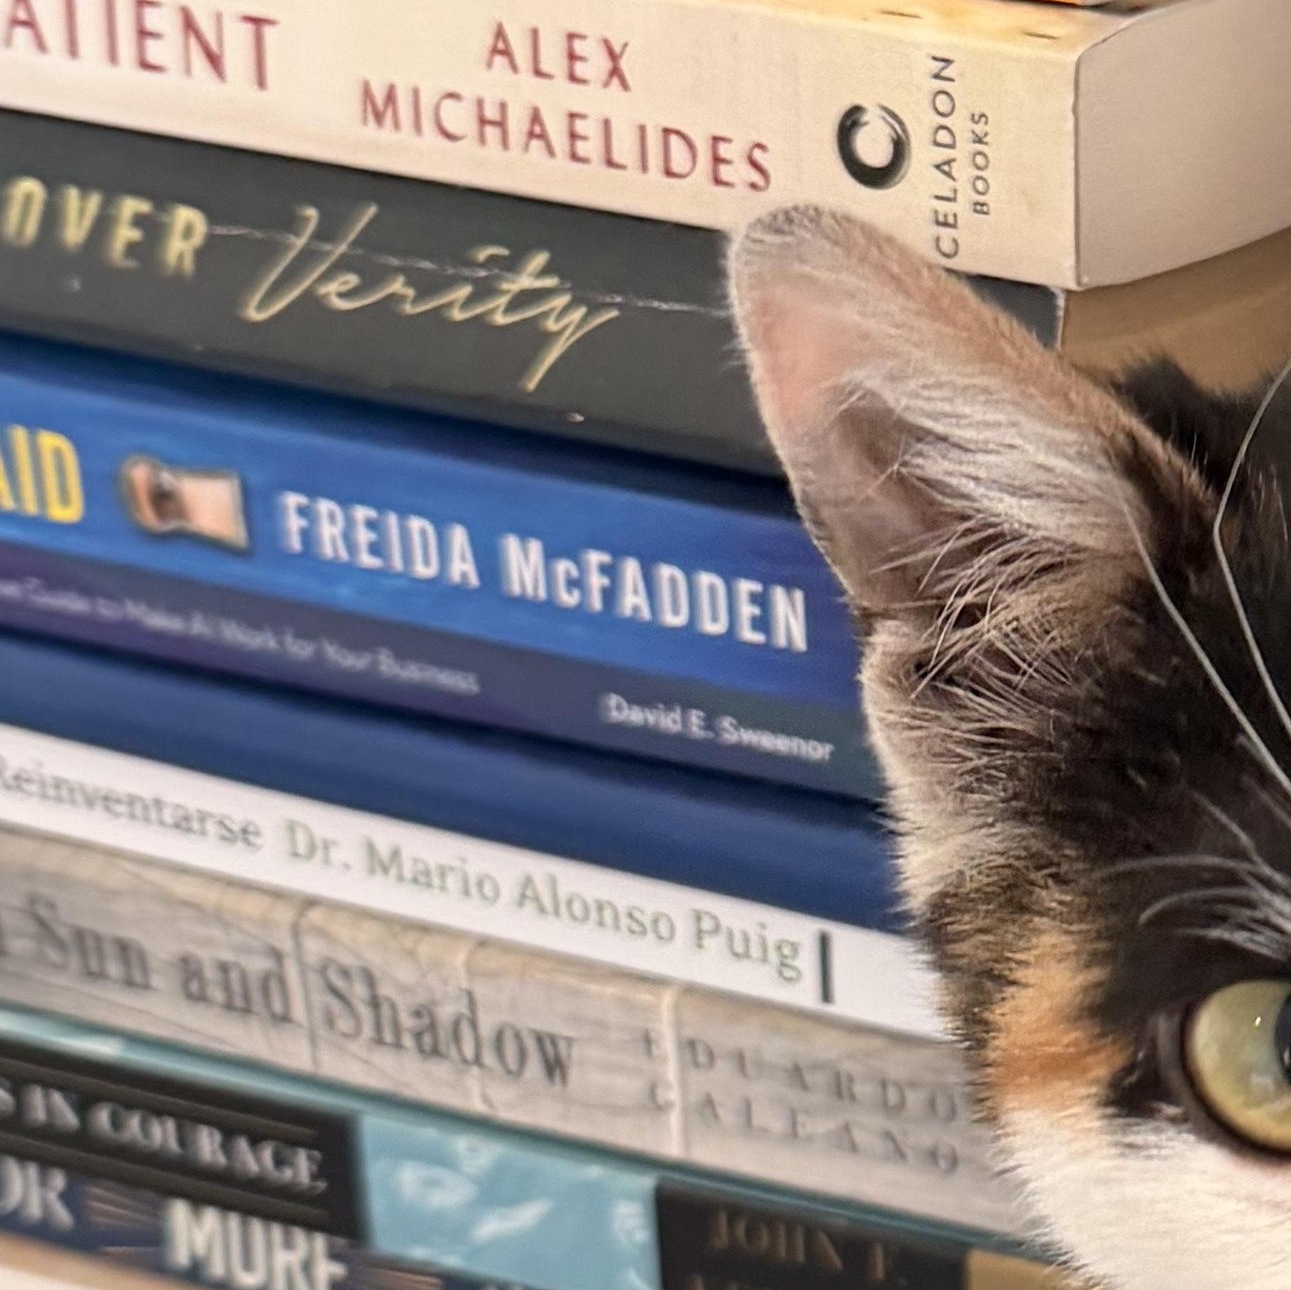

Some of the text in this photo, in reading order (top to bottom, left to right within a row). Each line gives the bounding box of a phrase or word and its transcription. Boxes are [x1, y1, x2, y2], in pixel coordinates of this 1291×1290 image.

[484, 19, 632, 93] ALEX
[361, 80, 772, 193] MICHAELIDES
[929, 54, 960, 261] CELADON
[971, 110, 989, 217] BOOKS
[2, 175, 209, 278] OVER
[240, 201, 619, 393] Verity
[0, 424, 808, 653] ID FREIDA McFADDEN
[604, 692, 681, 735] David
[684, 711, 711, 740] E.
[284, 818, 351, 871] Dr.
[365, 834, 499, 904] Mario
[516, 871, 677, 943] Alonso
[691, 907, 804, 982] Puig
[30, 893, 575, 1090] Sun and Shadow
[21, 1084, 80, 1133] IN
